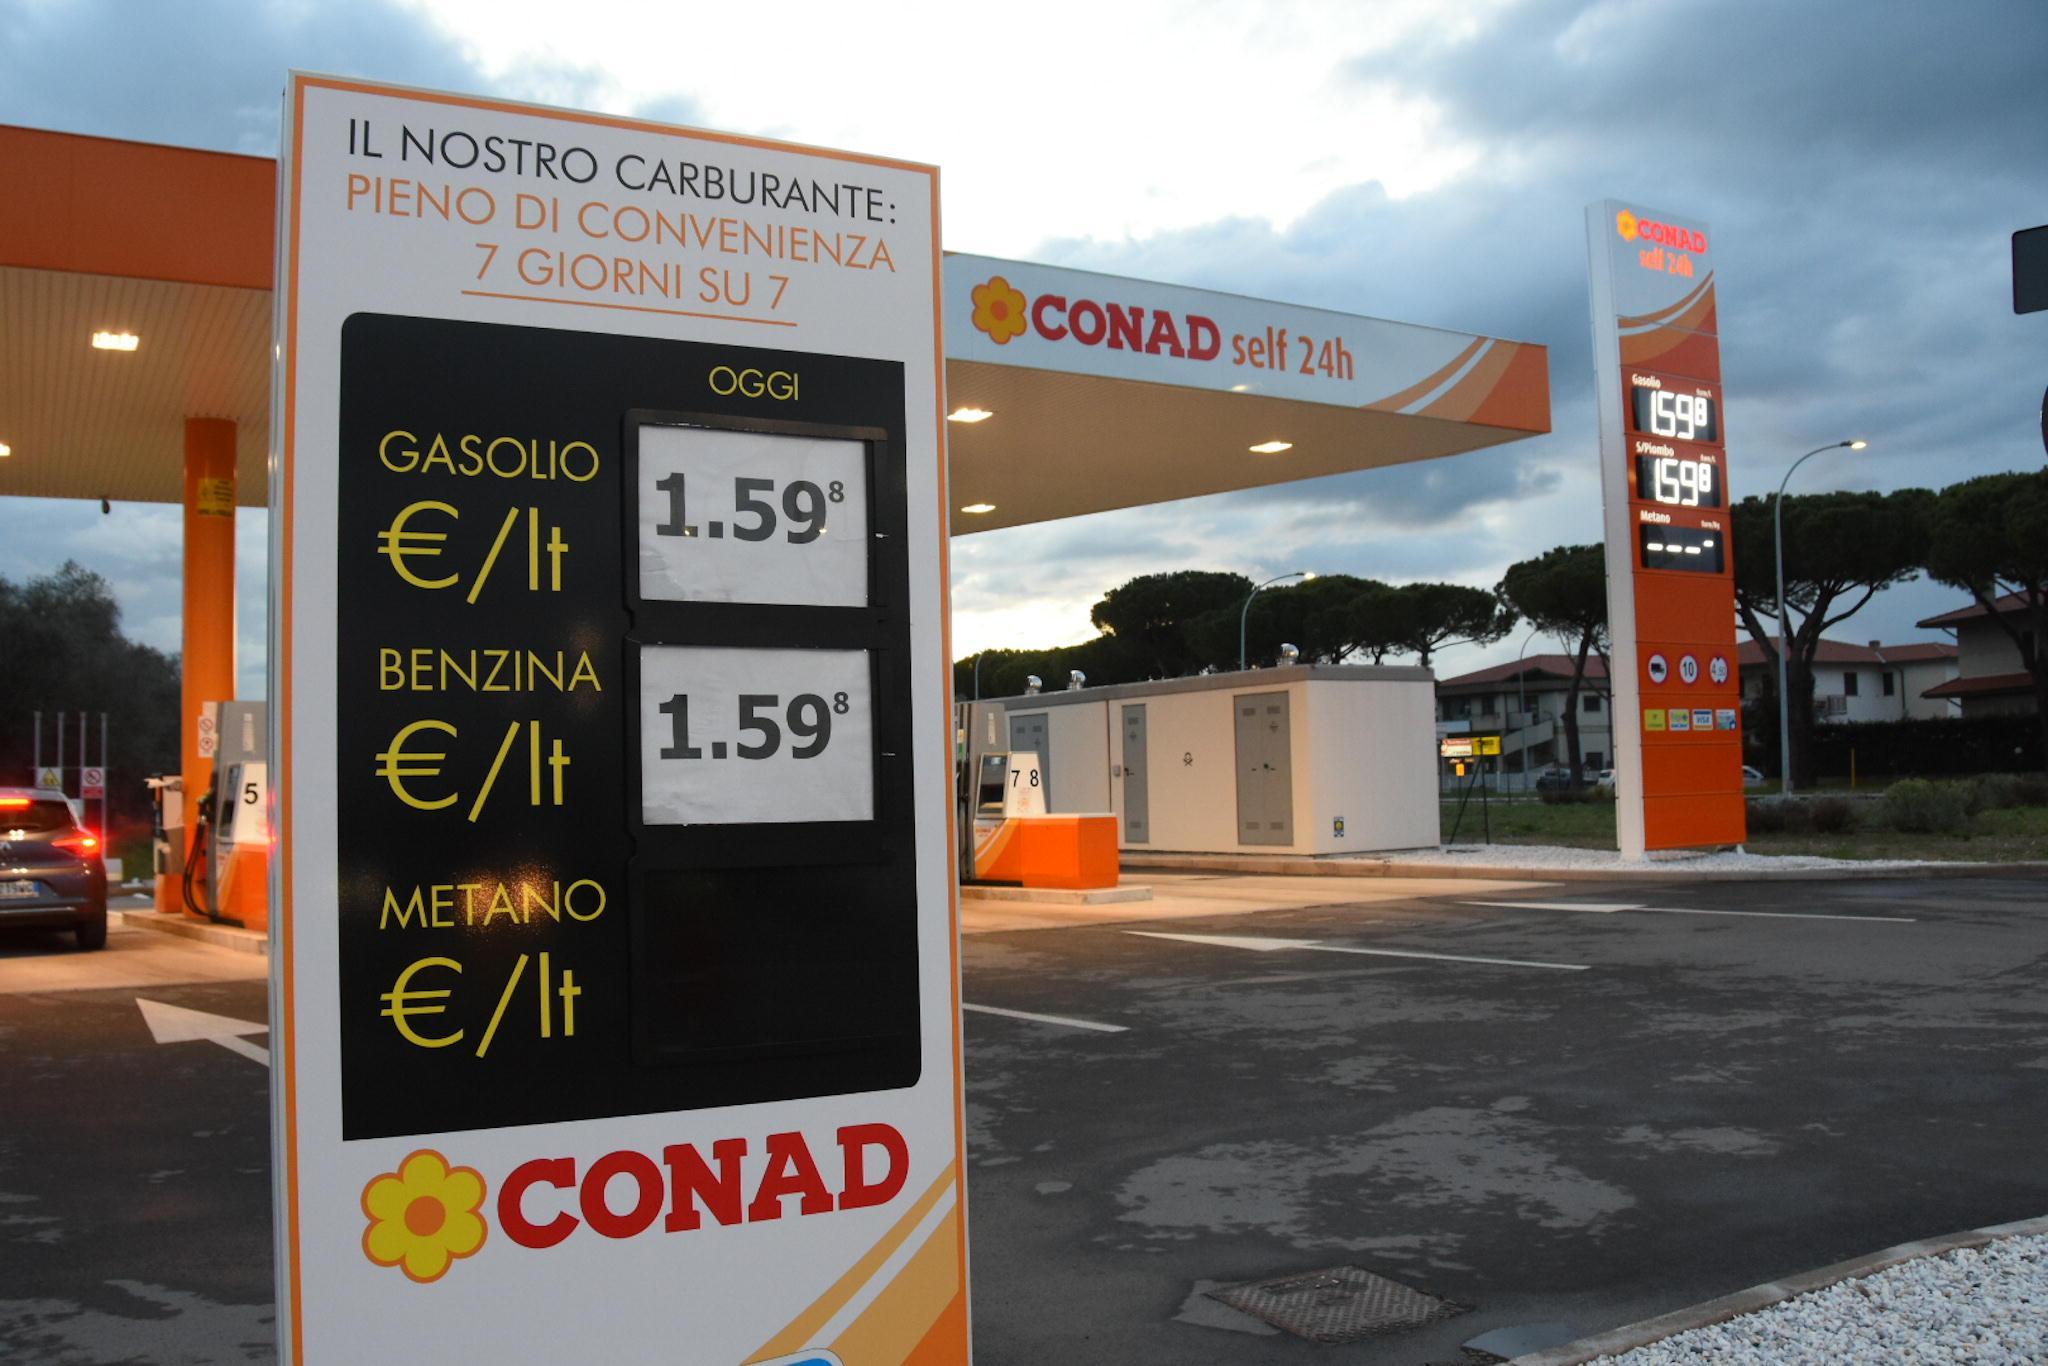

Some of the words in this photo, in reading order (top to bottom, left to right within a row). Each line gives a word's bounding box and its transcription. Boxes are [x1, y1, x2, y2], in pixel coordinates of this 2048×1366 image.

[349, 118, 383, 159] IL
[401, 125, 598, 184] NOSTRO
[615, 154, 896, 224] CARBURANTE:
[347, 172, 497, 225] PIENO
[515, 192, 560, 233] DI
[578, 200, 897, 272] CONVENIENZA
[1637, 219, 1707, 254] CONAD
[474, 242, 498, 281] 7
[517, 246, 683, 299] GIORNI
[699, 266, 753, 305] SU
[768, 274, 790, 310] 7
[1032, 295, 1221, 361] CONAD
[1232, 326, 1288, 371] self
[1299, 335, 1355, 380] 24h
[709, 365, 799, 401] OGGI
[1632, 373, 1661, 389] Gasolio
[379, 430, 600, 482] GASOLIO
[1640, 509, 1671, 525] Metano
[380, 648, 602, 693] BENZINA
[1683, 661, 1694, 677] 10
[244, 782, 258, 805] 5
[1011, 770, 1021, 788] 7
[1030, 769, 1039, 787] 8
[379, 879, 607, 930] METANO
[498, 1122, 912, 1249] CONAD
